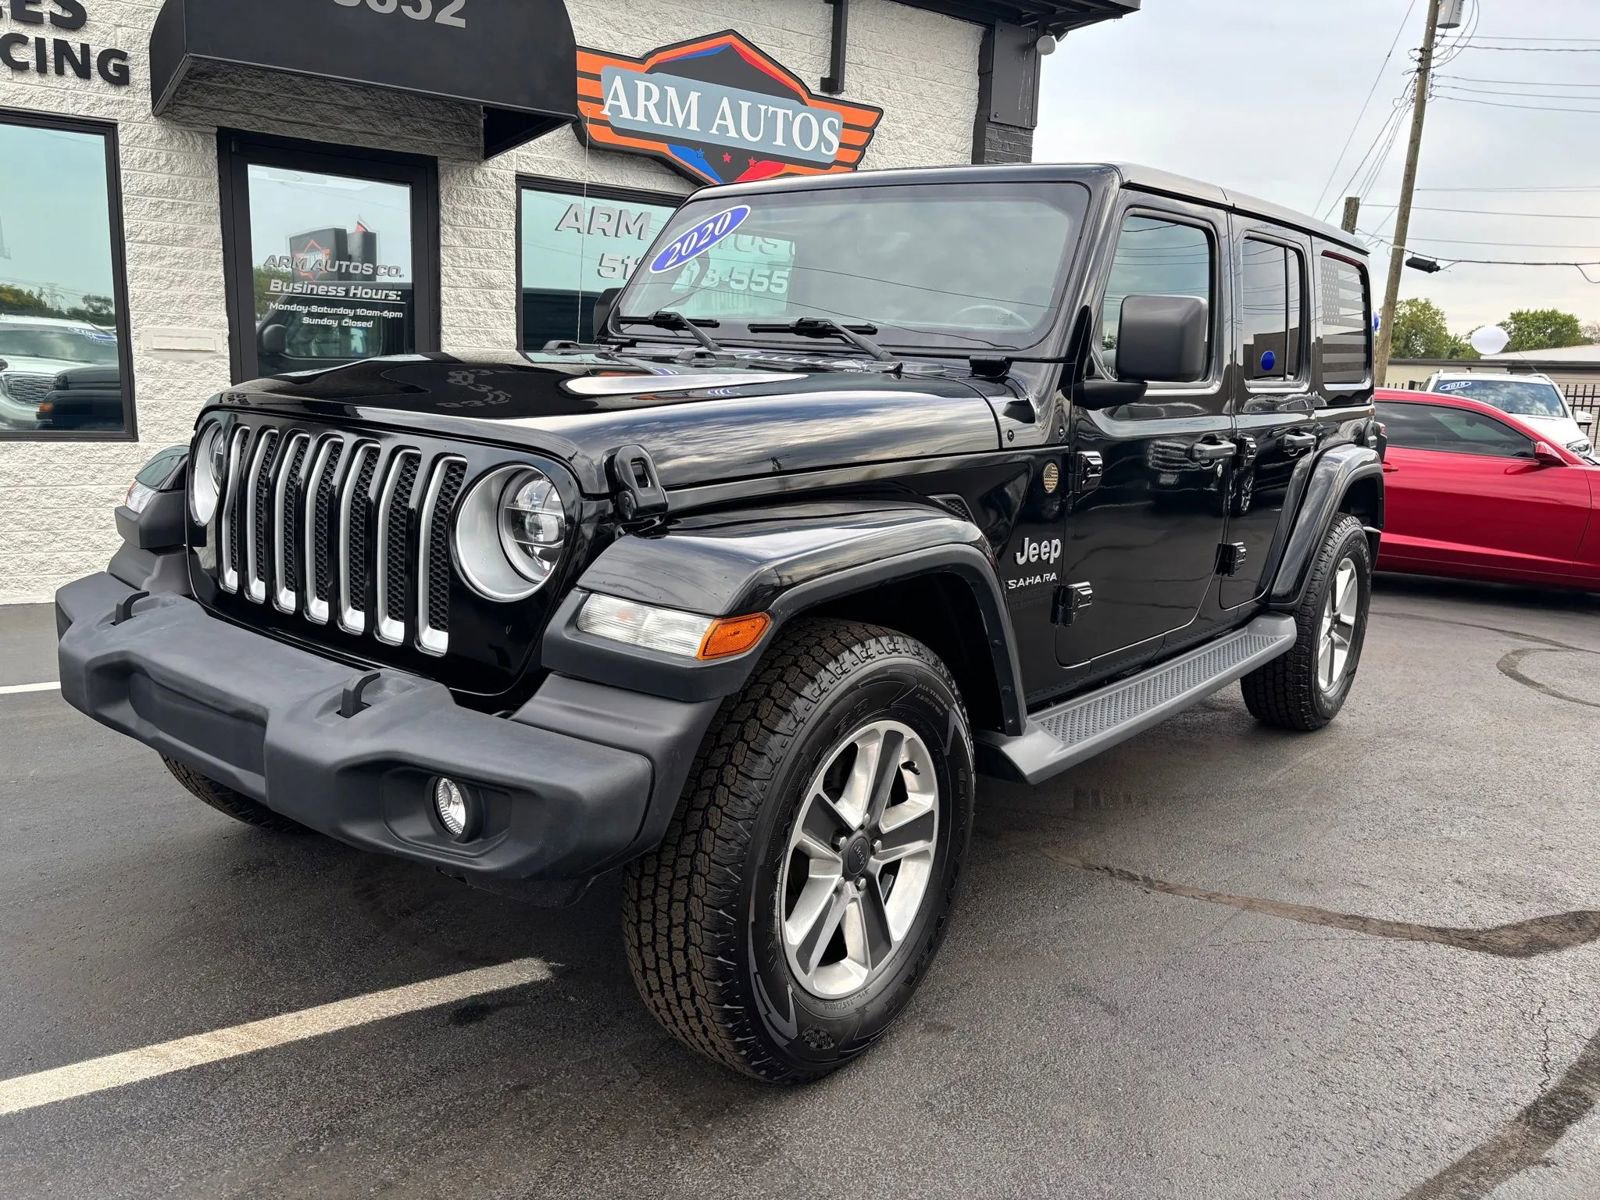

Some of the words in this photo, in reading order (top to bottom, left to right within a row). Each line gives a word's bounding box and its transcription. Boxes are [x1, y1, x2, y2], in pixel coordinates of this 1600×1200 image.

[0, 0, 88, 30] ES
[600, 75, 701, 131] ARM
[709, 97, 840, 155] AUTOS
[555, 203, 651, 240] ARM
[664, 212, 731, 268] 2020
[264, 255, 307, 272] ARM
[310, 259, 374, 275] AUTOS
[376, 265, 404, 278] CO.
[270, 279, 346, 297] Business
[350, 285, 402, 300] Hours:
[269, 302, 354, 316] Monday-Saturday
[356, 308, 403, 319] 10am-6pm
[303, 316, 338, 327] Sunday
[342, 318, 373, 328] Closed
[1016, 537, 1061, 565] Jeep
[1008, 572, 1057, 589] SAHARA
